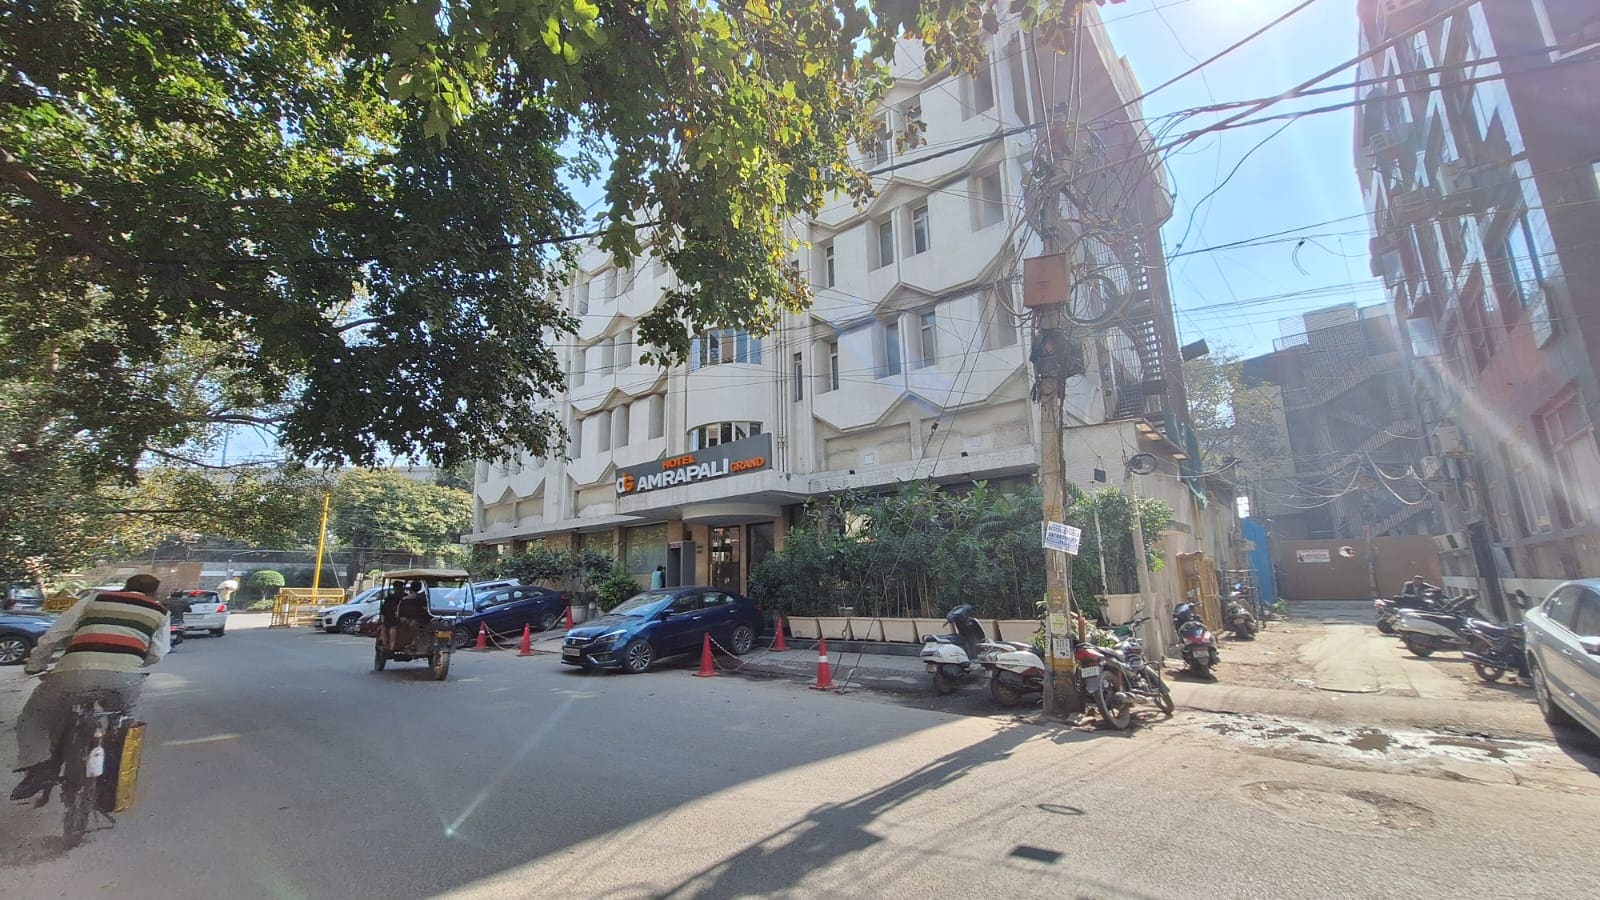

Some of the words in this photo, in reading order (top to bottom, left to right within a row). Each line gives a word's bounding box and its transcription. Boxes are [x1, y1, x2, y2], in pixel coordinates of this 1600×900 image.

[637, 458, 729, 491] AMRAPALI
[730, 456, 765, 472] GRAND
[663, 455, 695, 469] HOTEL
